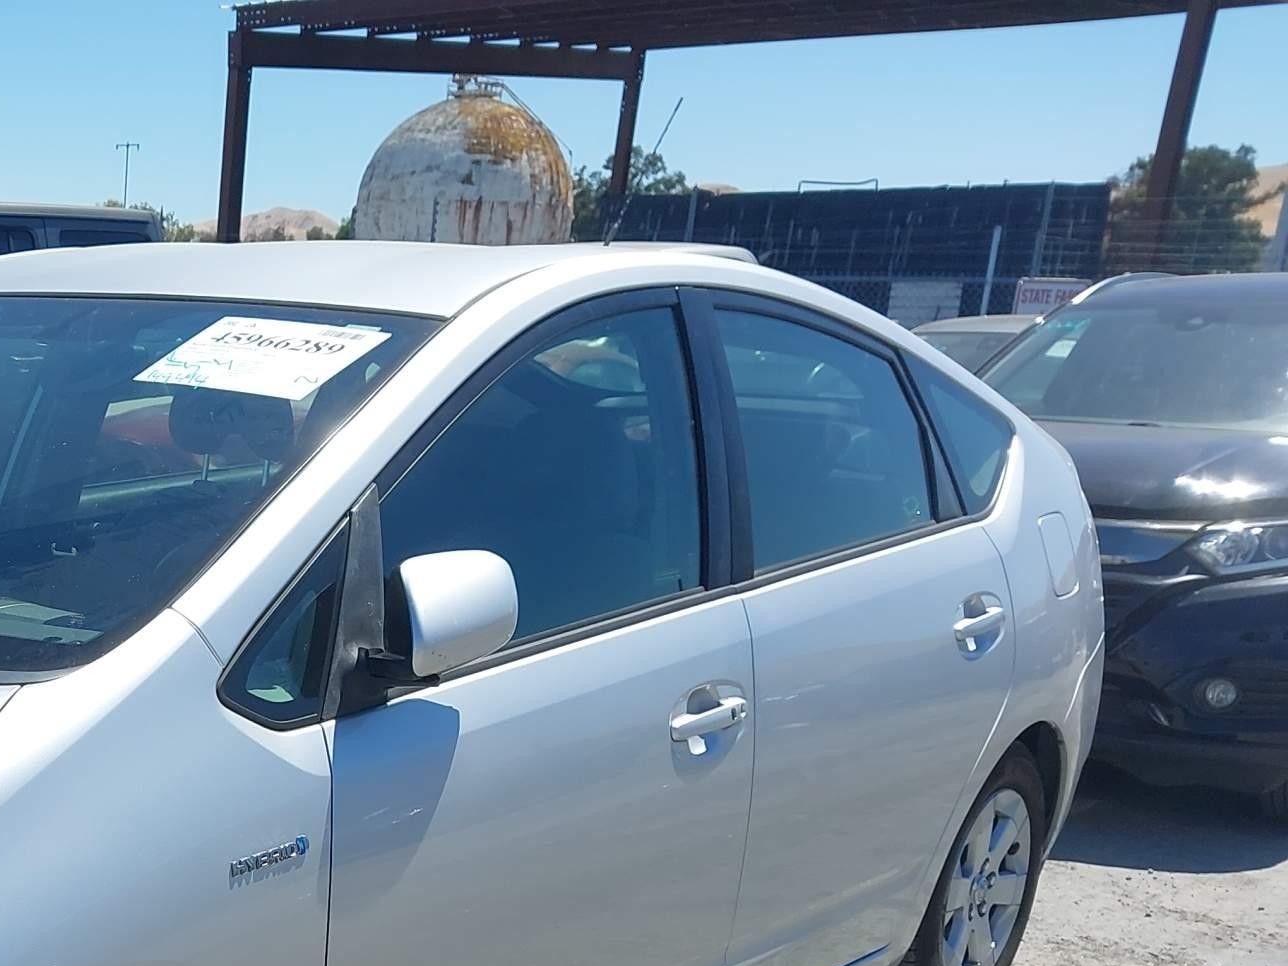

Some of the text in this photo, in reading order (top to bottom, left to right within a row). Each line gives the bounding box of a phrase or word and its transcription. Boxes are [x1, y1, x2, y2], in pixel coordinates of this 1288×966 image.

[1021, 287, 1082, 304] STATE FAR
[210, 331, 345, 356] 45966289
[230, 839, 302, 878] HYBRID
